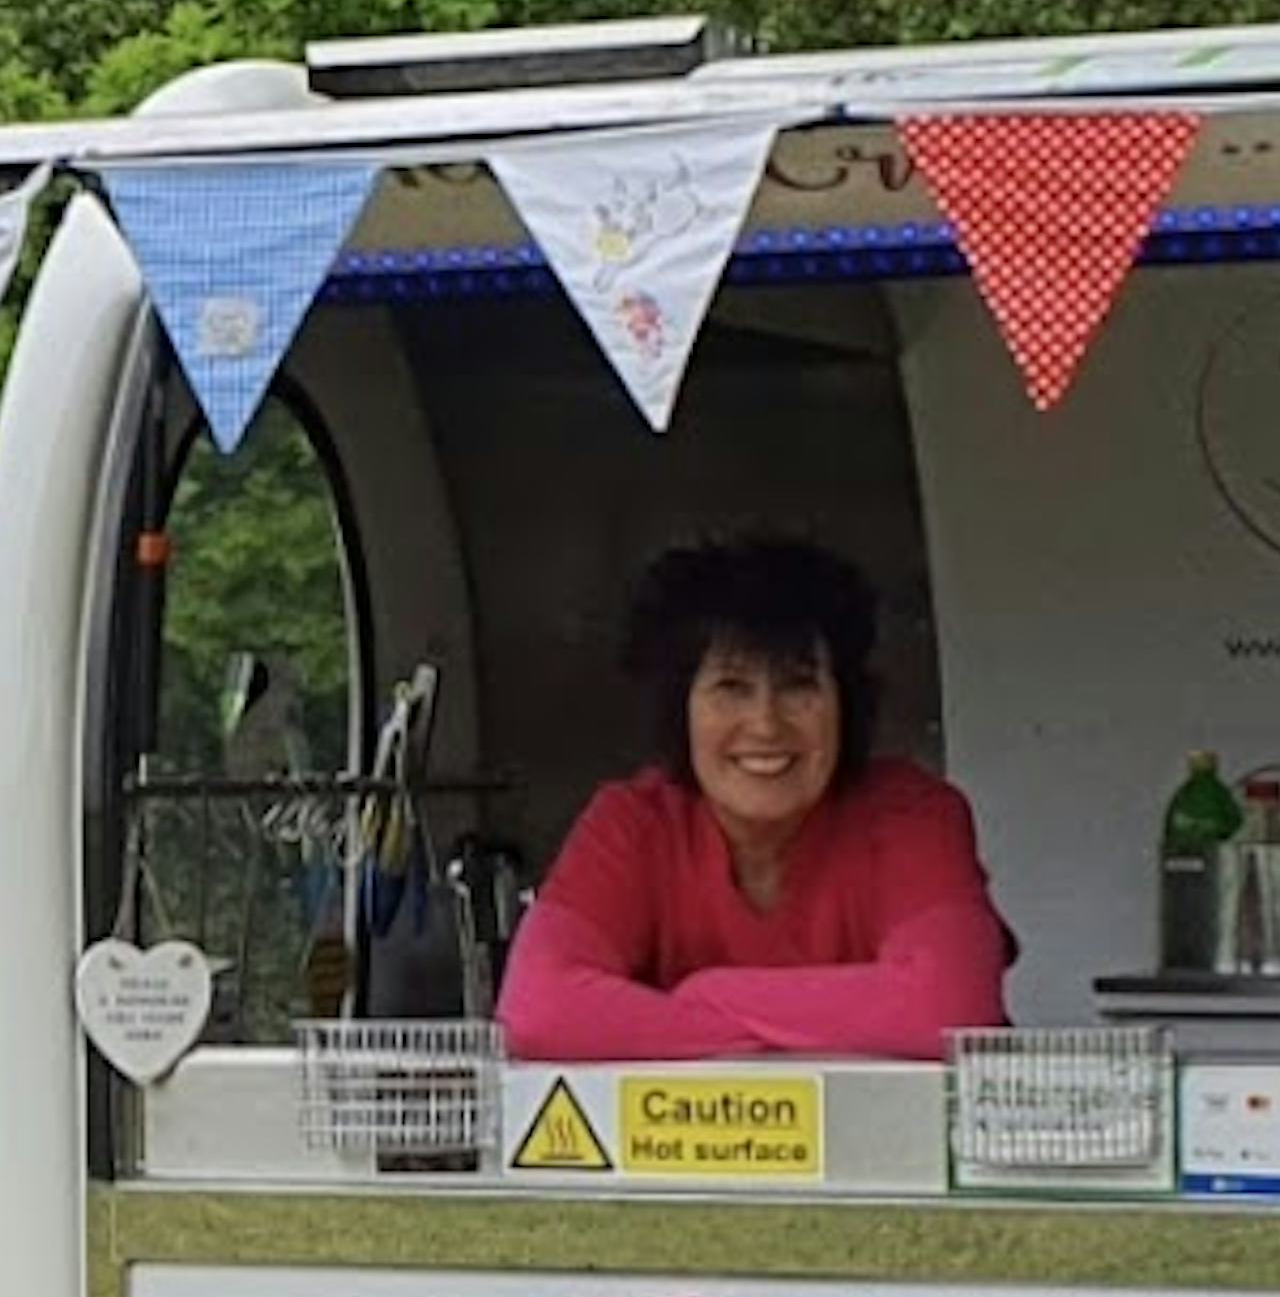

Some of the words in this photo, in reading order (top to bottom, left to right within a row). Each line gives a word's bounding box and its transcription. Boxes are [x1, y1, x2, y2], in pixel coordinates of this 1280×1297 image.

[642, 1089, 796, 1125] Caution
[630, 1137, 684, 1162] Hot
[695, 1137, 808, 1163] surface
